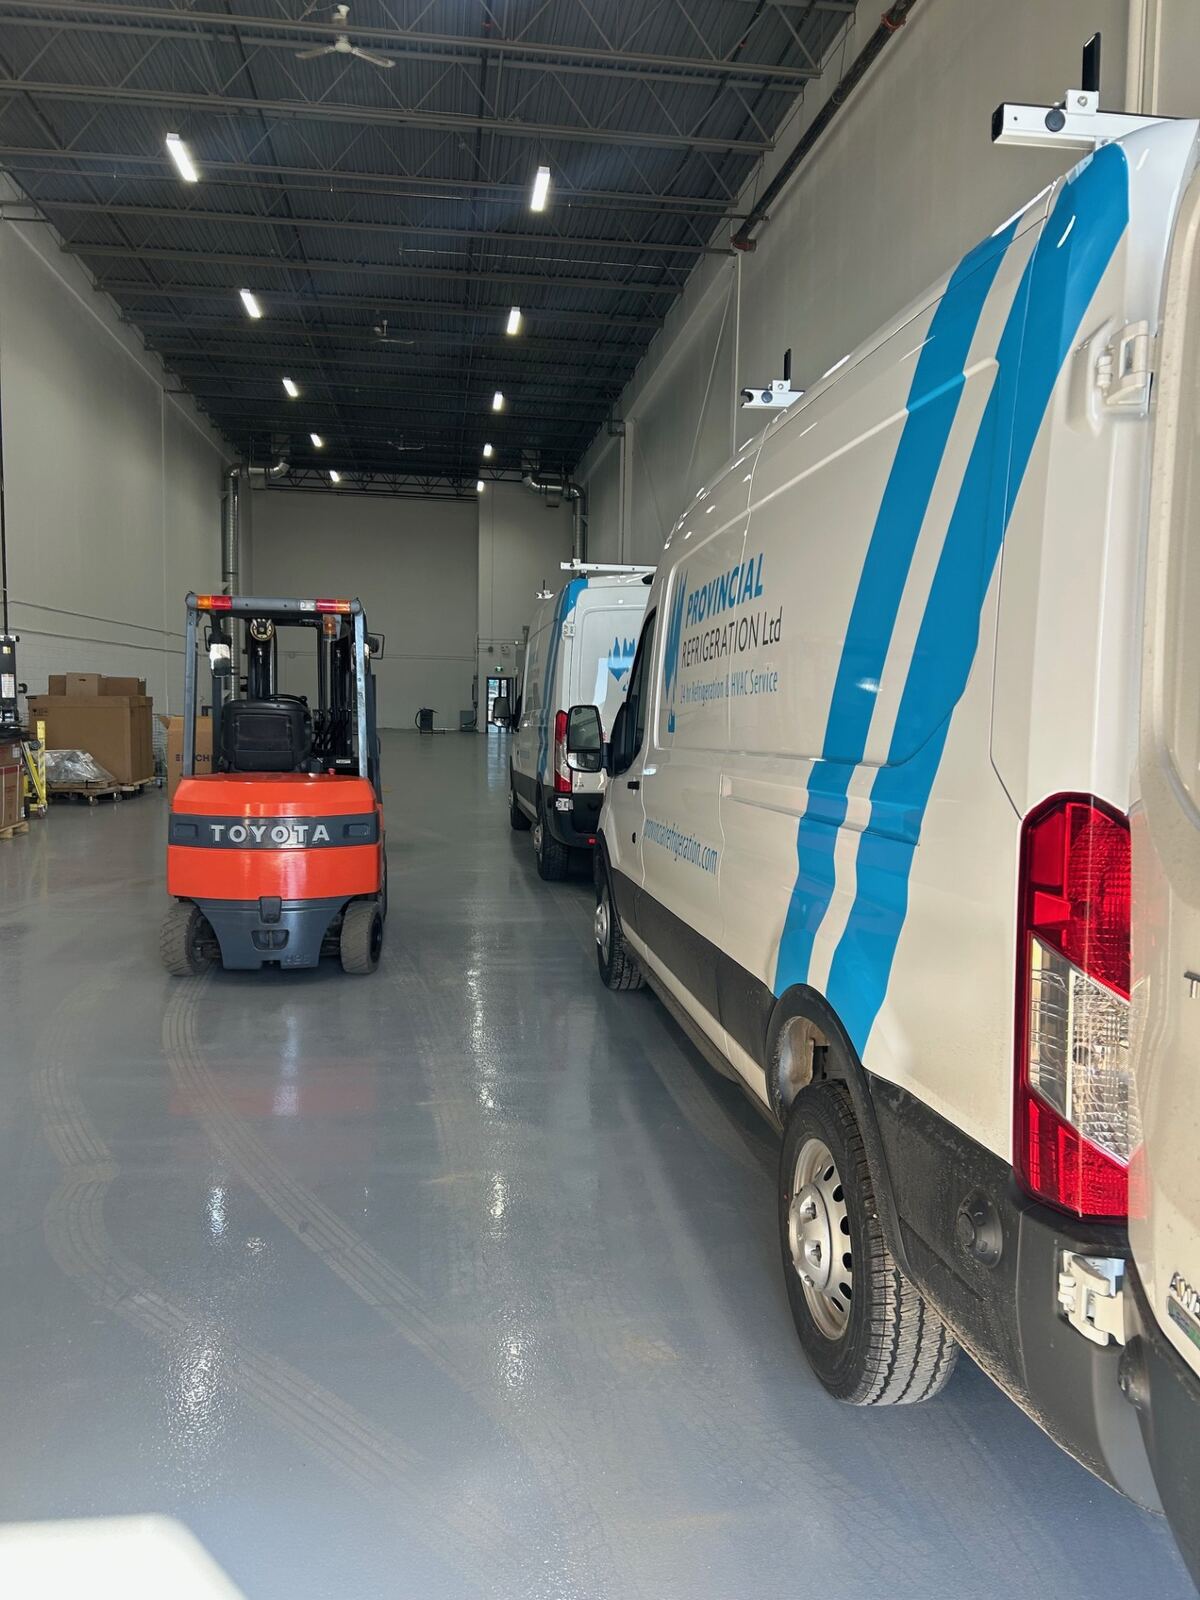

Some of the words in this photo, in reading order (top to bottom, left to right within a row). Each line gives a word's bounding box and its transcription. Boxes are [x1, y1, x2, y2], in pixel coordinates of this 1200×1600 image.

[685, 552, 763, 629] PROVINCIAL
[681, 612, 760, 668] REFRIGERATION
[762, 606, 783, 645] Ltd
[731, 670, 748, 697] HVAC
[749, 667, 778, 695] Service
[210, 824, 330, 843] TOYOTA
